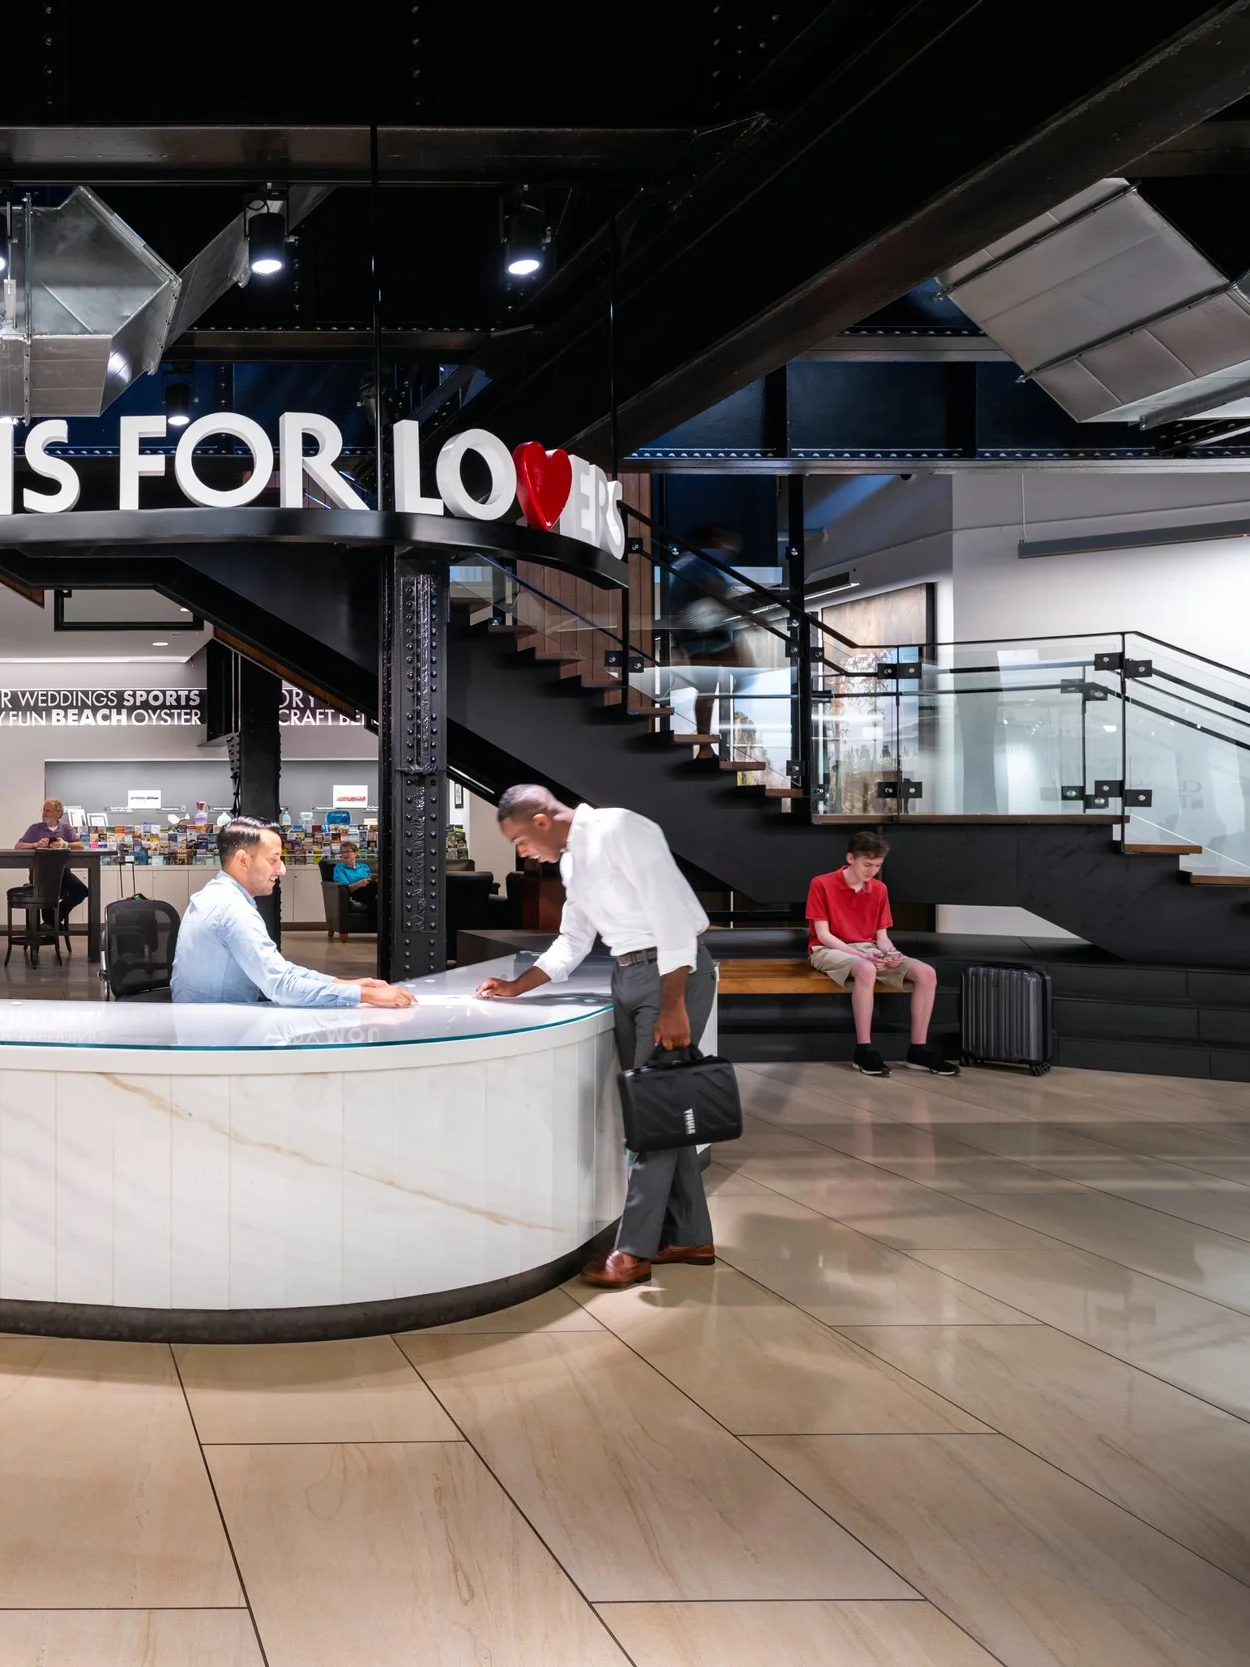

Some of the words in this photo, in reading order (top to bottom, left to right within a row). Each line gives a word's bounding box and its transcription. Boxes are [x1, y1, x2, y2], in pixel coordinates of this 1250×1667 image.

[119, 411, 370, 510] FOR
[18, 690, 118, 707] WEDDINGS
[123, 690, 200, 706] SPORTS
[9, 711, 46, 726] FUN
[51, 709, 128, 726] BEACH
[132, 709, 201, 726] OYSTER
[278, 709, 335, 726] CRAFT
